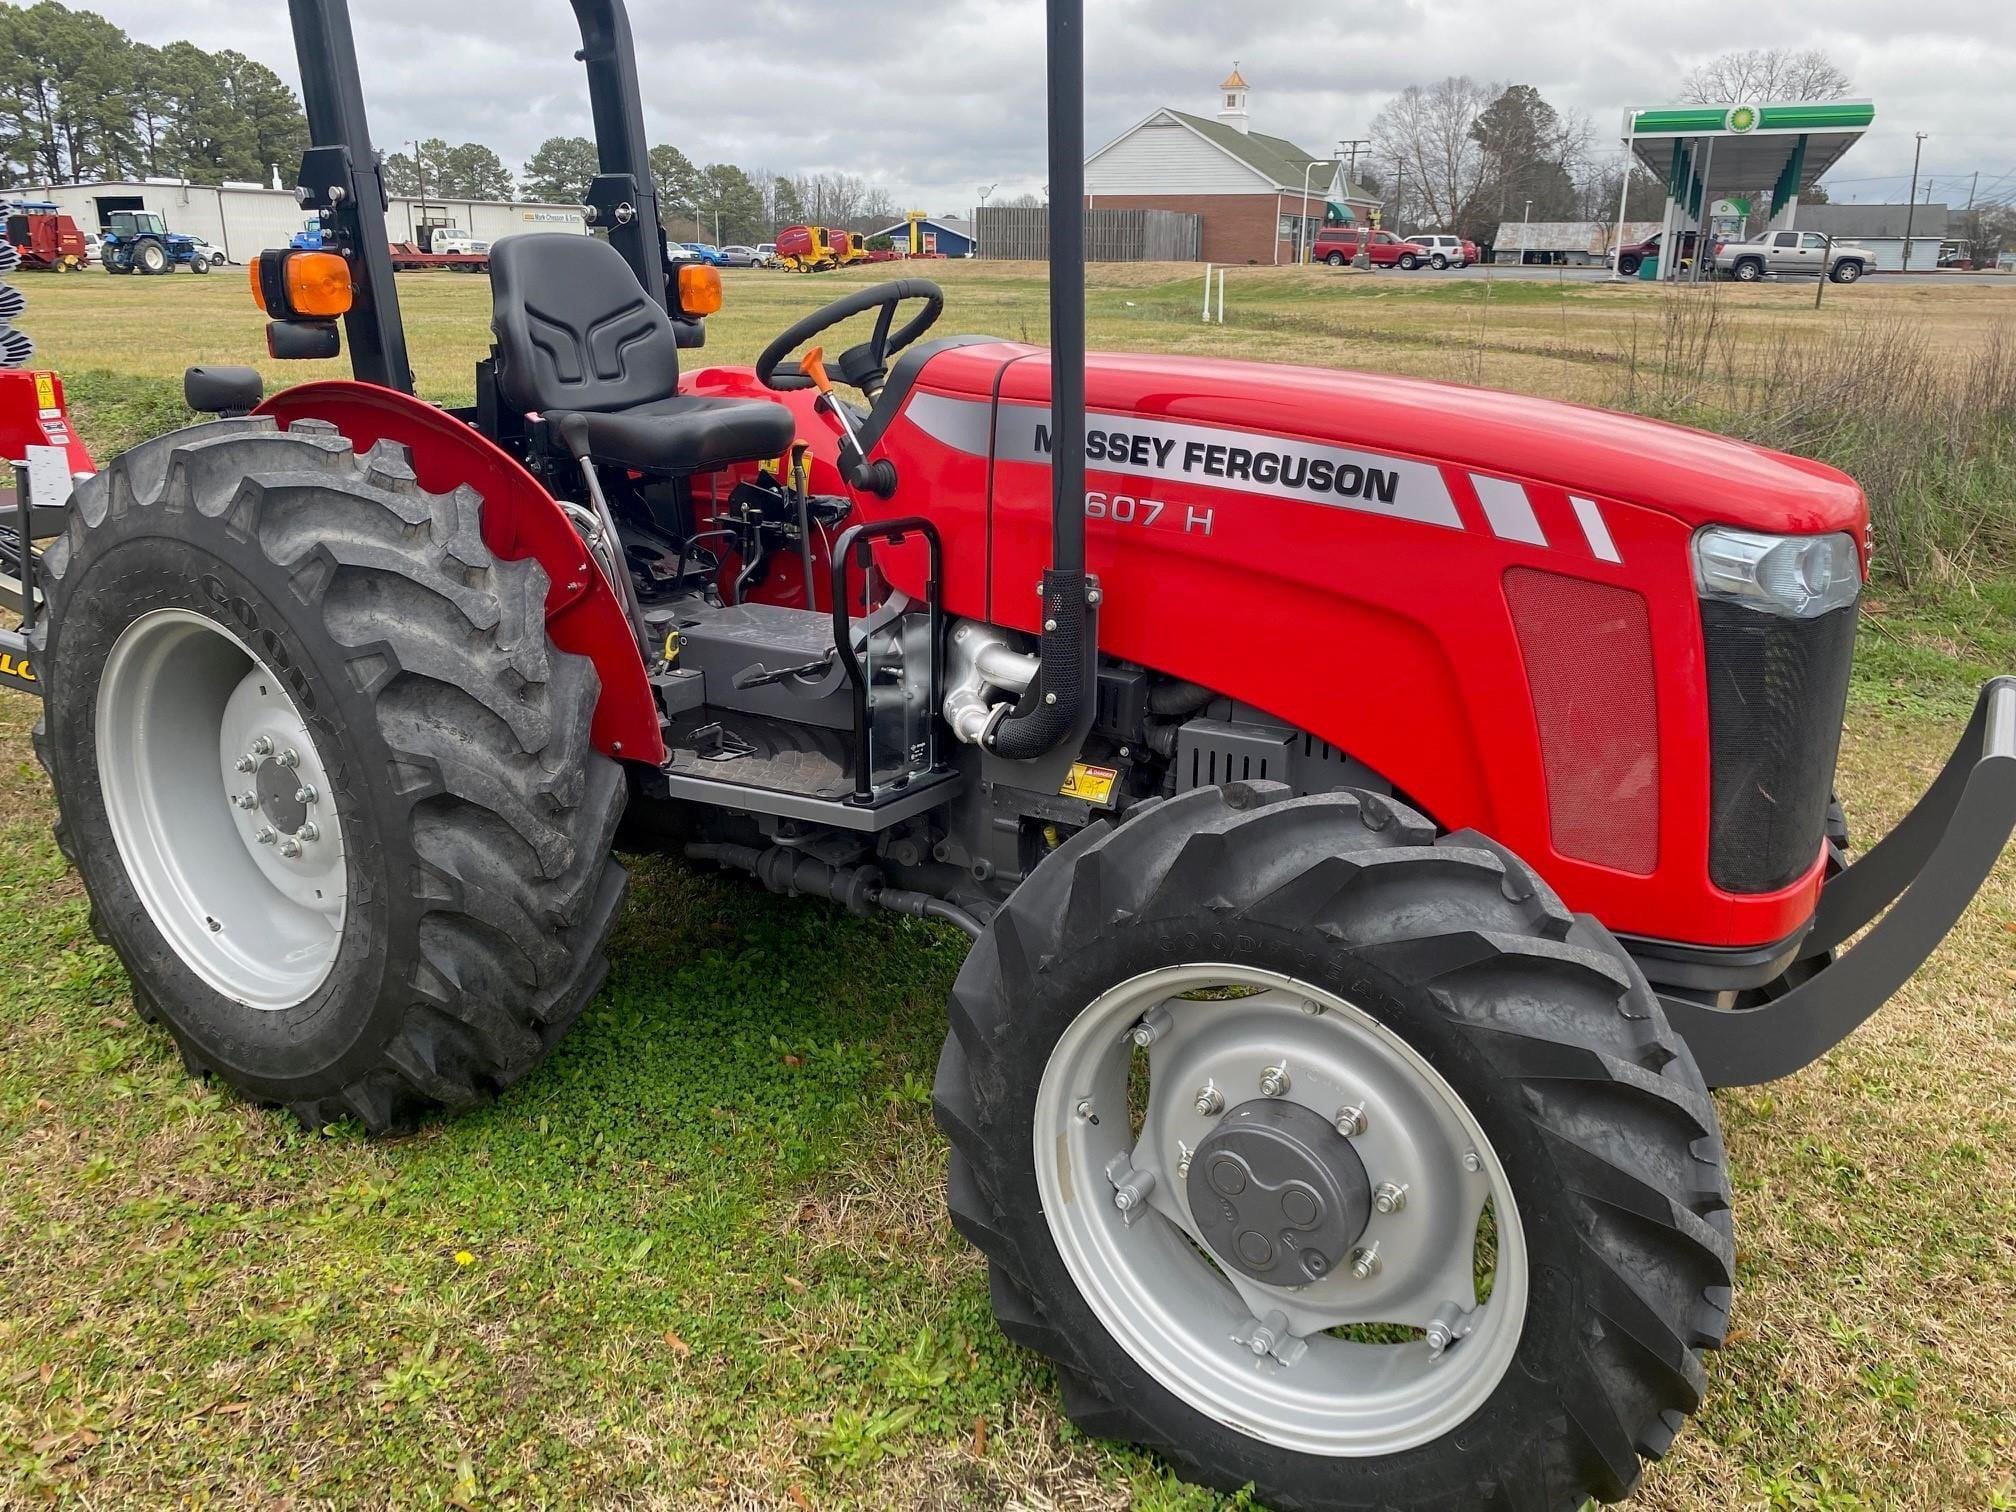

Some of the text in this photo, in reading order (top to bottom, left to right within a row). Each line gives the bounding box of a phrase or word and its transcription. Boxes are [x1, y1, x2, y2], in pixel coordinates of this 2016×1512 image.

[1034, 424, 1399, 505] MSSEY FERGUSON
[1184, 504, 1214, 536] H
